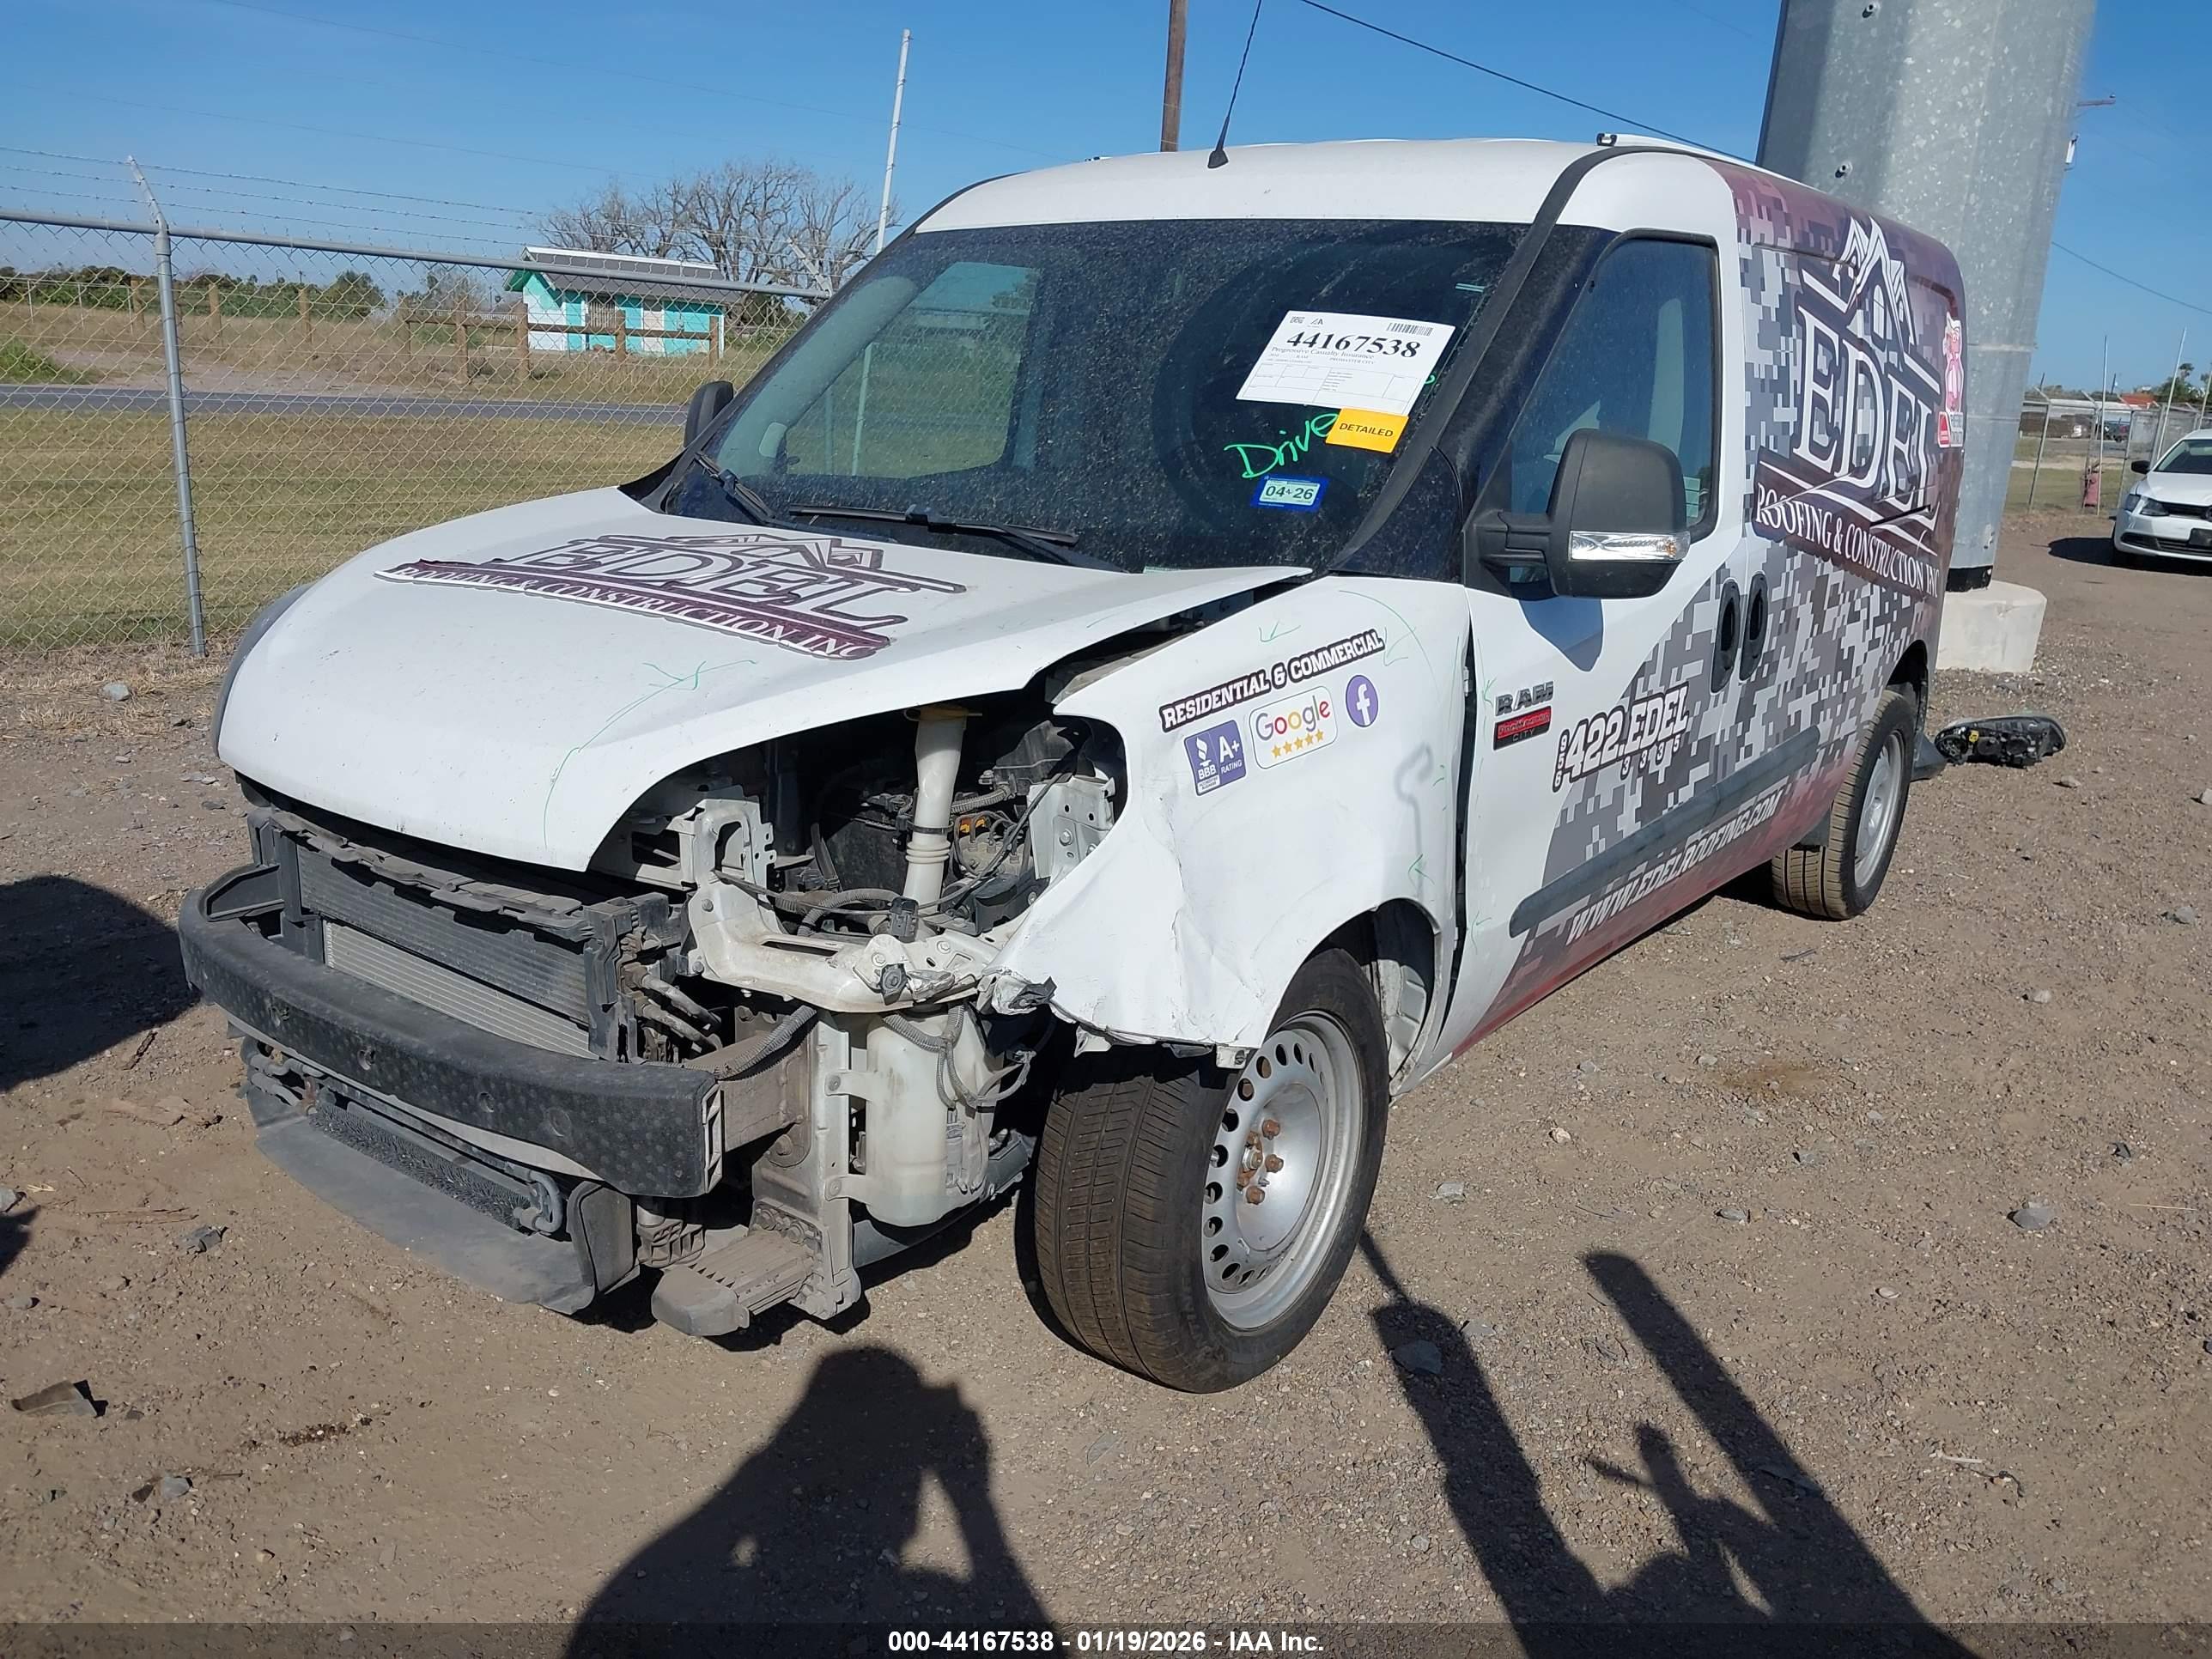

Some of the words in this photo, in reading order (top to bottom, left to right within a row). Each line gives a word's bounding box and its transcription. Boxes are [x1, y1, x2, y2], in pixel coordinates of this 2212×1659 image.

[1286, 331, 1421, 358] 44167538
[1340, 422, 1394, 437] DETAILED
[1794, 306, 1941, 532] EDEL
[1266, 486, 1285, 497] 04
[1292, 488, 1316, 500] 26
[1756, 483, 1832, 549] ROOFING
[1833, 518, 1844, 555] &
[1845, 523, 1923, 592] CONSTRUCTION
[1925, 563, 1940, 598] INC
[513, 537, 908, 629] EDEL
[394, 567, 514, 587] ROOFING
[514, 579, 539, 591] &
[536, 582, 801, 641] CONSTRUCTION
[797, 633, 876, 658] INC
[1162, 672, 1269, 729] RESIDENTIAL
[1273, 665, 1286, 685] &
[1290, 631, 1383, 679] COMMERCIAL
[1495, 681, 1553, 716] RAM
[1255, 695, 1330, 741] Google
[1219, 736, 1240, 763] A+
[1512, 728, 1535, 742] CITY
[1198, 764, 1217, 780] BBB
[1221, 759, 1243, 774] RATING
